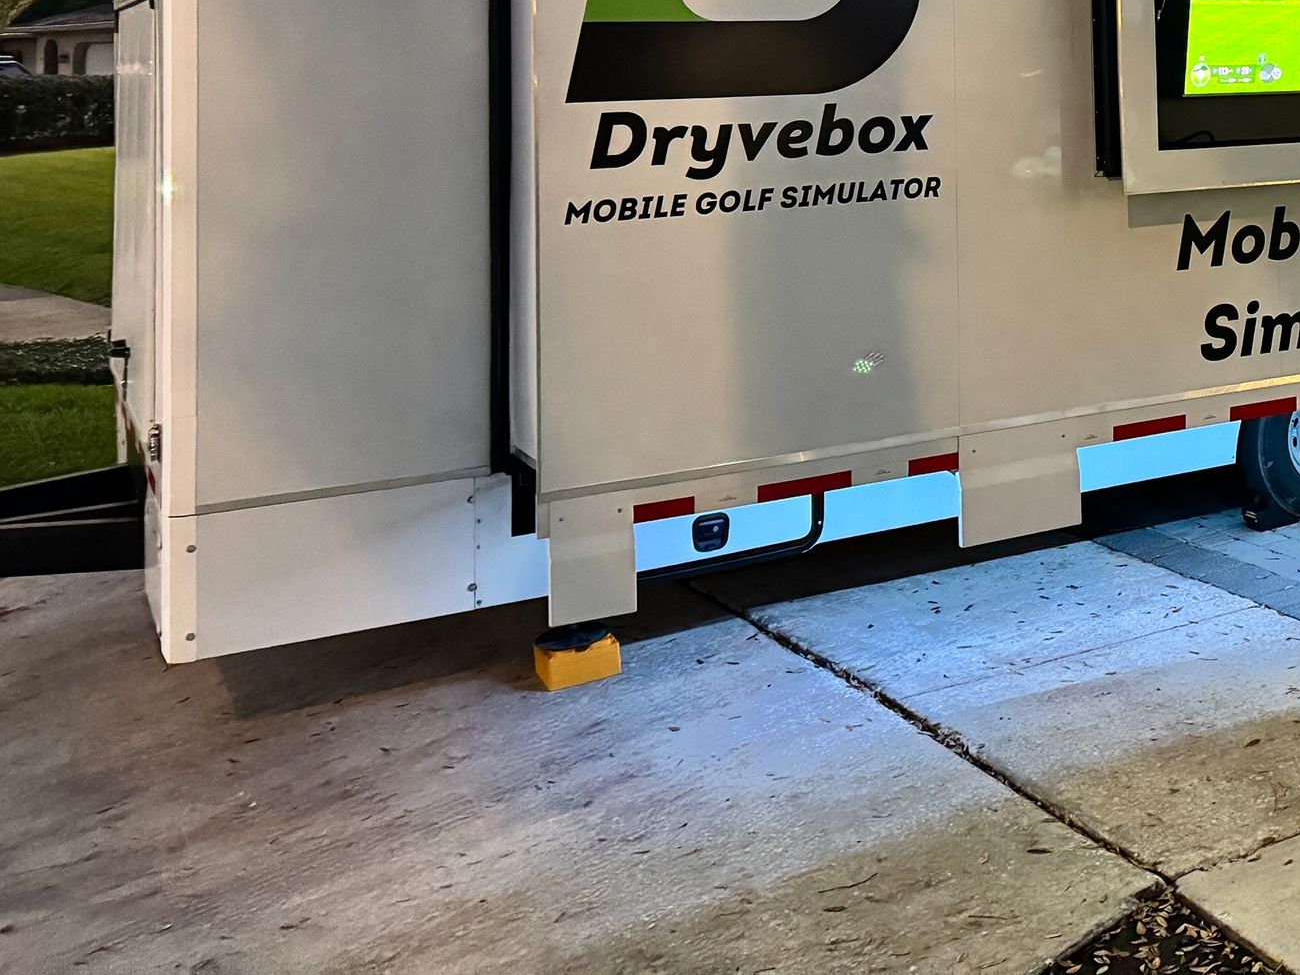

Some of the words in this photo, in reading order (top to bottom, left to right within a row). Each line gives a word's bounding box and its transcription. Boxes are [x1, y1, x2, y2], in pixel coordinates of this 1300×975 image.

[590, 103, 933, 180] Dryvebox
[564, 193, 688, 225] MOBILE
[695, 187, 775, 215] GOLF
[780, 176, 941, 209] SIMULATOR
